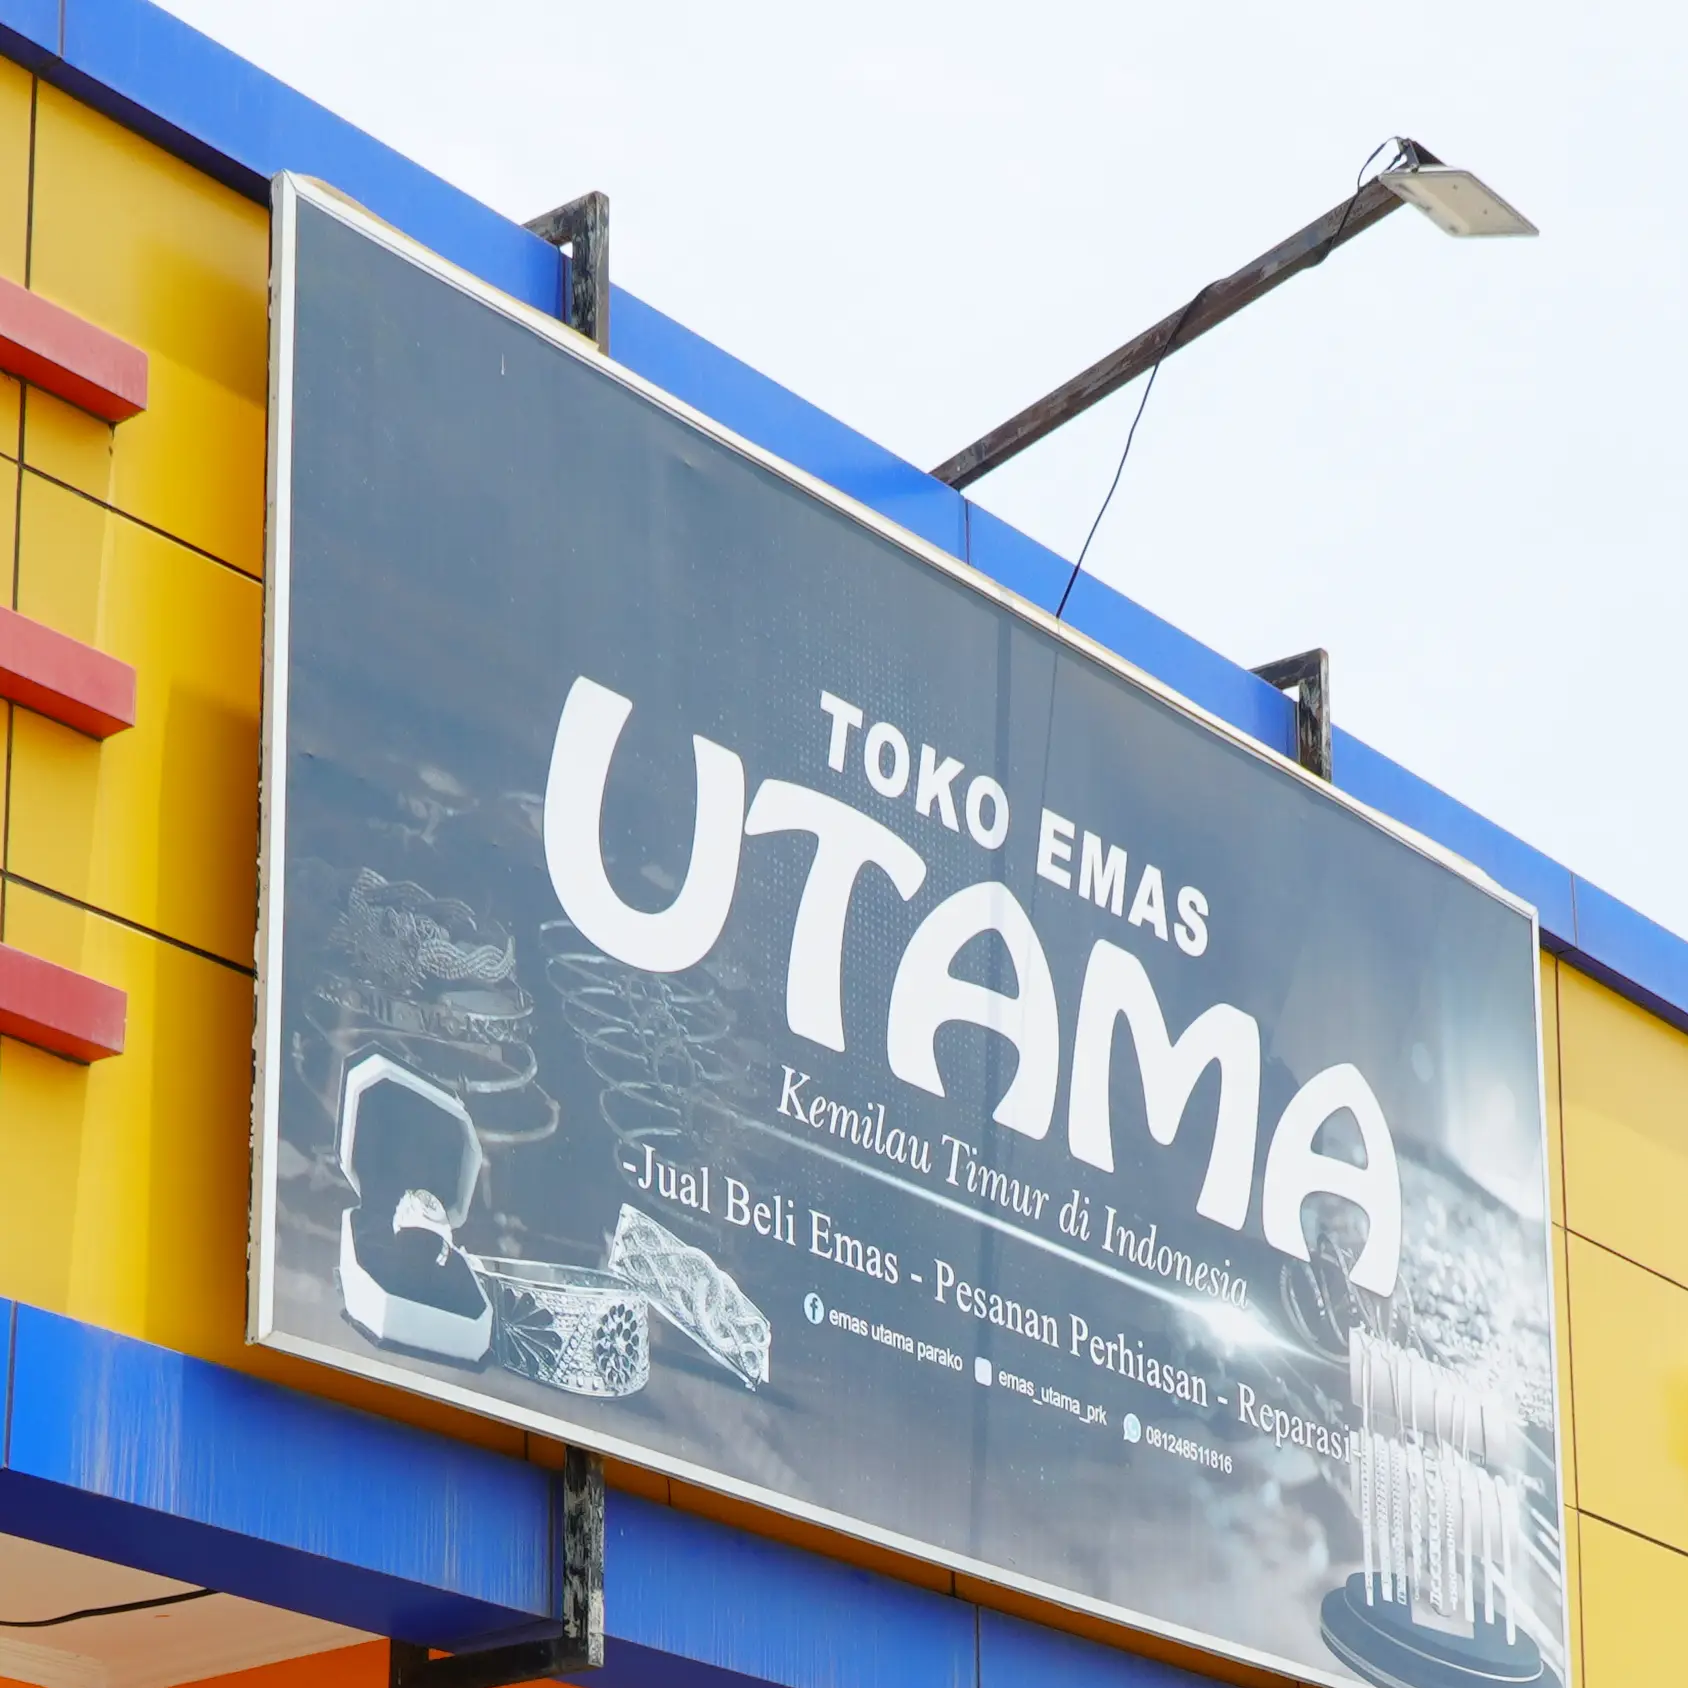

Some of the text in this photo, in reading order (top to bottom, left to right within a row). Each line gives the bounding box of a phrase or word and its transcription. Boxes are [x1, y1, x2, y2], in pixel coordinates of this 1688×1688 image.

[820, 690, 1209, 957] TOKO EMAS
[543, 676, 1402, 1299] UTAMA
[724, 1176, 796, 1246] Beli
[808, 1209, 899, 1285] Emas
[934, 1258, 1060, 1348] Pesanan
[1069, 1313, 1207, 1407] Perhiasan
[777, 1064, 1249, 1309] Kemilau Timur di Indonesia
[829, 1308, 963, 1371] emas utama parako
[998, 1370, 1108, 1426] emas_utama_prk
[1146, 1425, 1233, 1475] 081248511816
